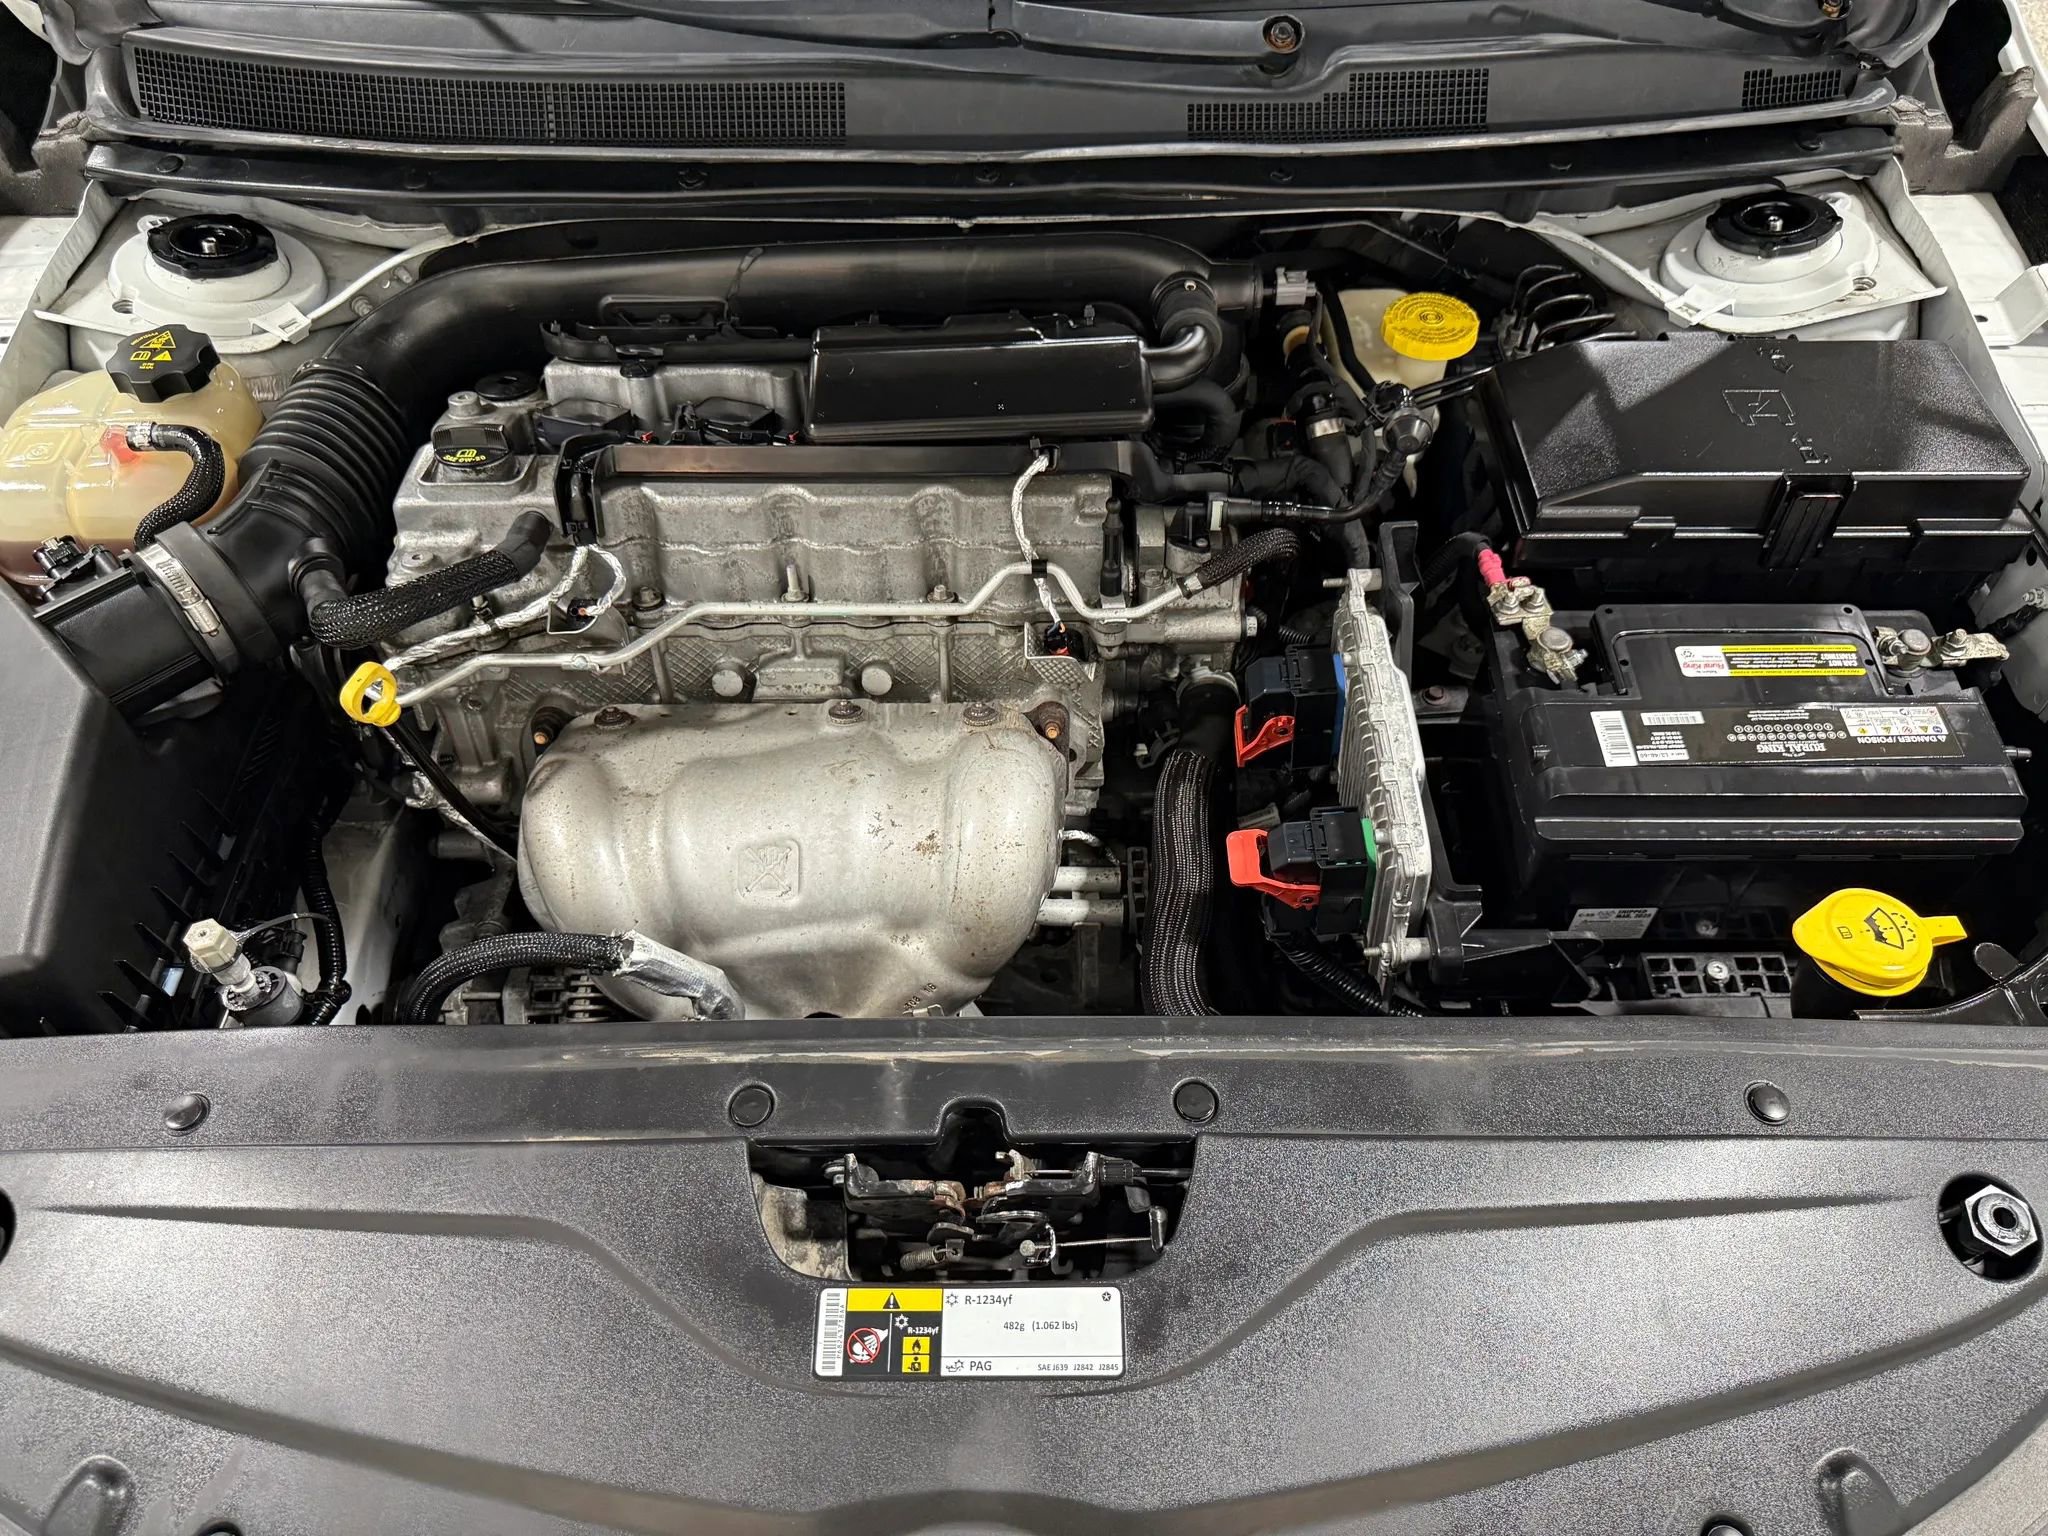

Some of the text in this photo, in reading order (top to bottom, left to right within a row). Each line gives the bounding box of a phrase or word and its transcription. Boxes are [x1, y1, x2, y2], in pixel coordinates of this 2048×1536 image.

[1757, 743, 1826, 753] RURAL KING
[964, 1294, 1013, 1305] R-1234yf
[907, 1326, 940, 1336] R-1234yf
[1003, 1320, 1078, 1332] 482g (1.062 lbs)
[969, 1360, 992, 1371] PAG
